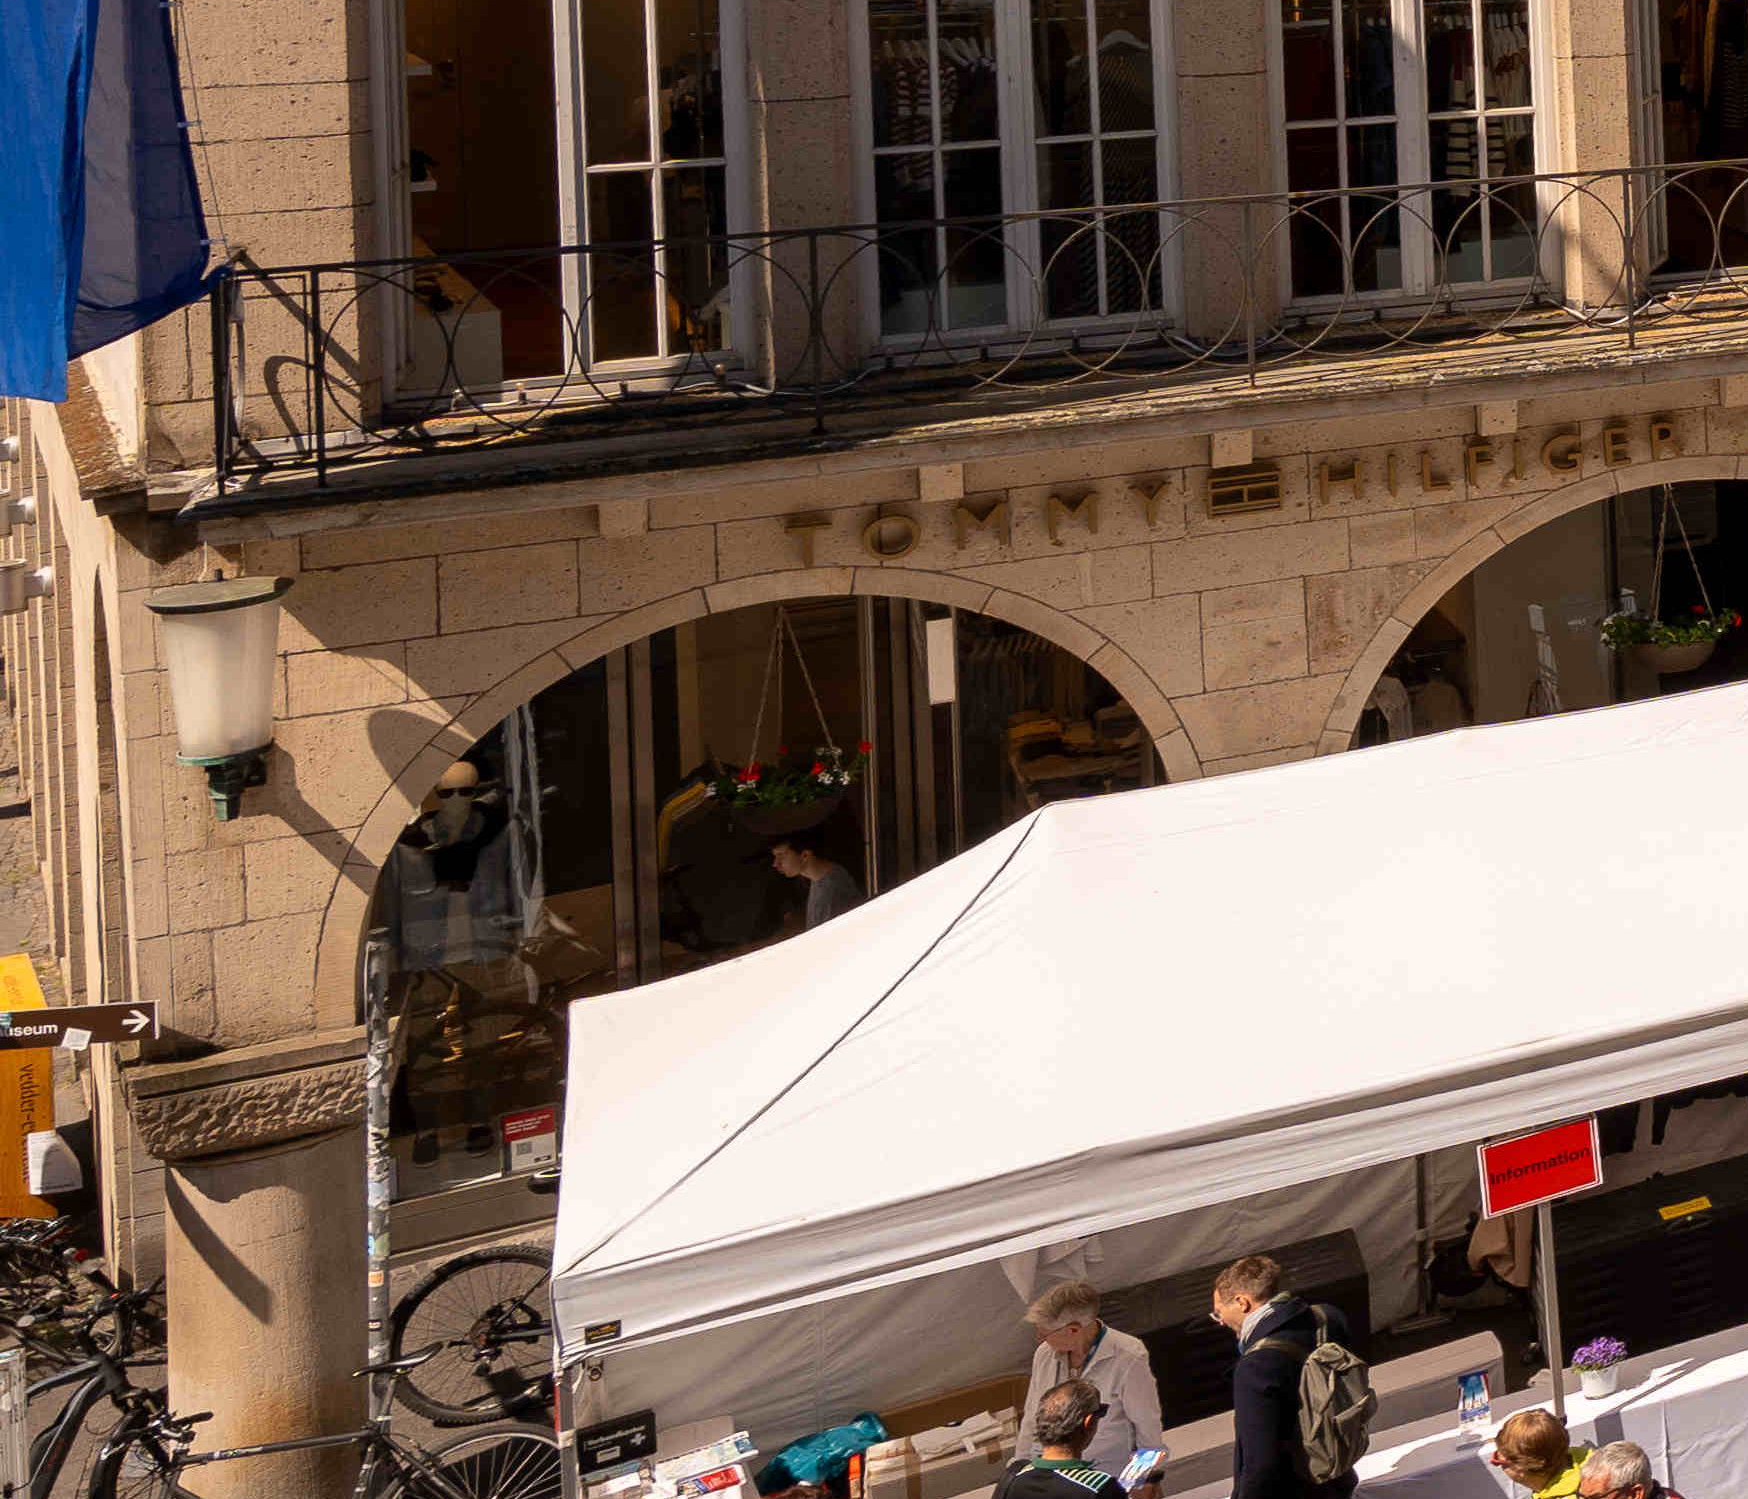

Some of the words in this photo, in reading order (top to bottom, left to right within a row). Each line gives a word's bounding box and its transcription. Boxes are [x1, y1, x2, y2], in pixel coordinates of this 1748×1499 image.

[784, 477, 1172, 569] TOMMY
[1316, 421, 1683, 502] HILFIGER
[1488, 1146, 1592, 1186] Information
